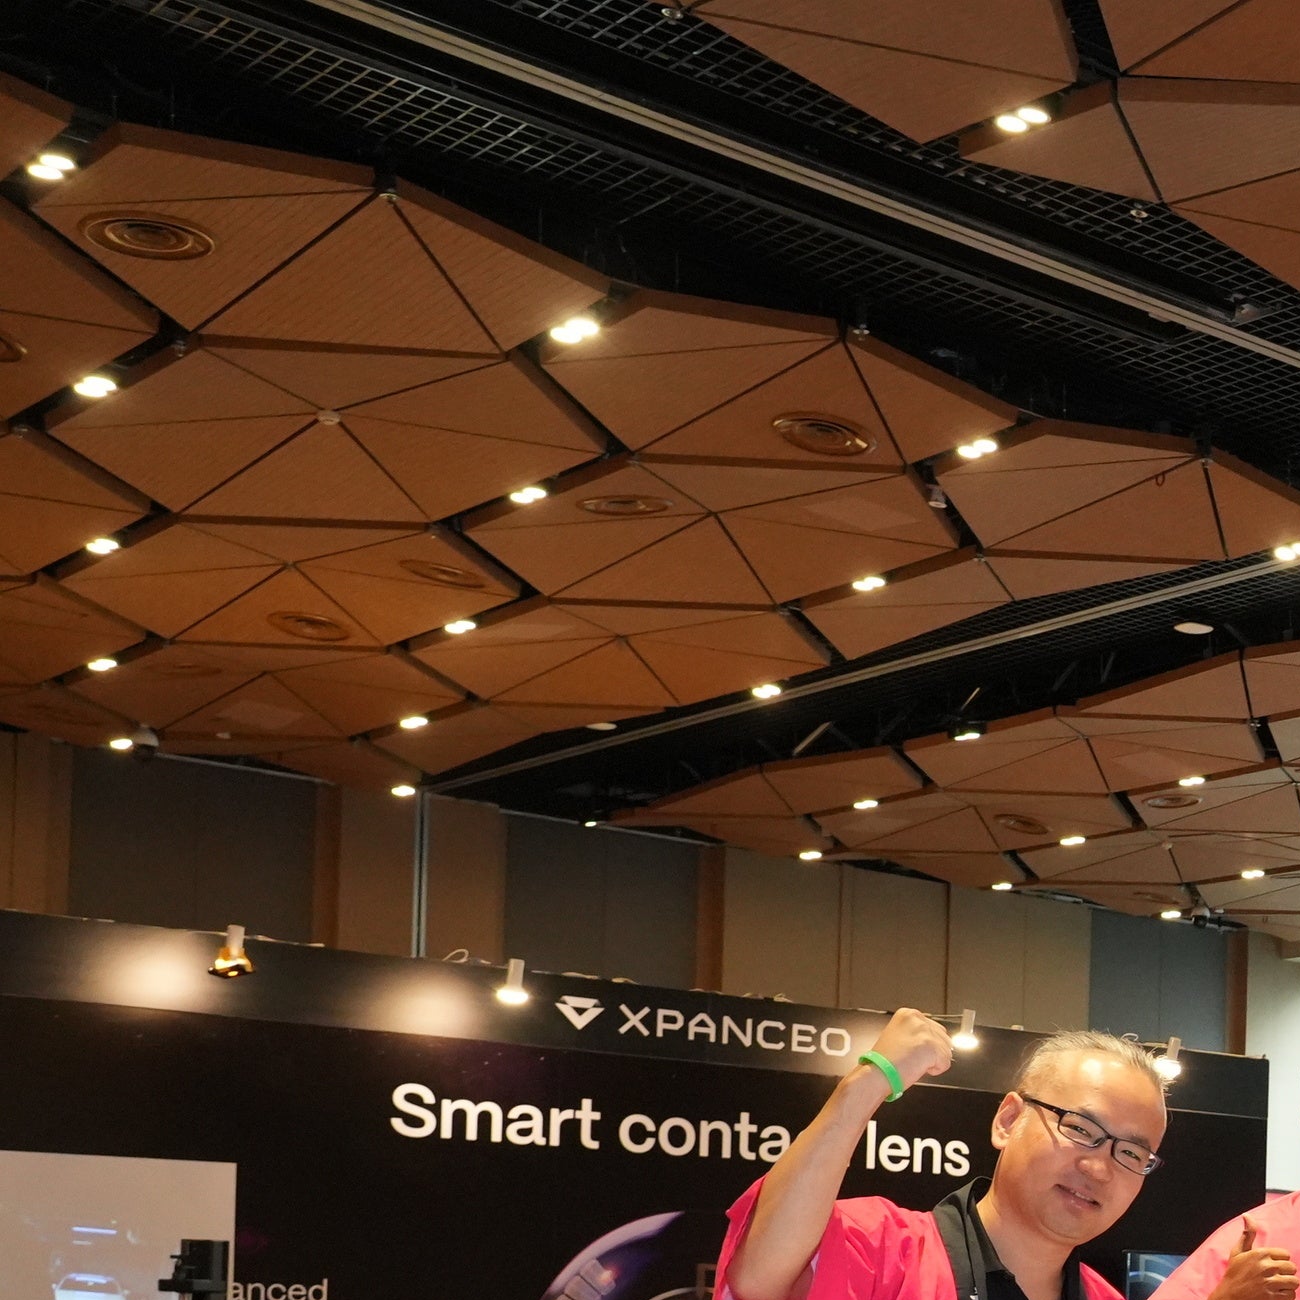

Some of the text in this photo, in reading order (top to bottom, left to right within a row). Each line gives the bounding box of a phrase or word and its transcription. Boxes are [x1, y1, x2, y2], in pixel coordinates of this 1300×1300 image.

[618, 1003, 851, 1057] XPANCEO
[390, 1082, 970, 1179] Smart conta lens
